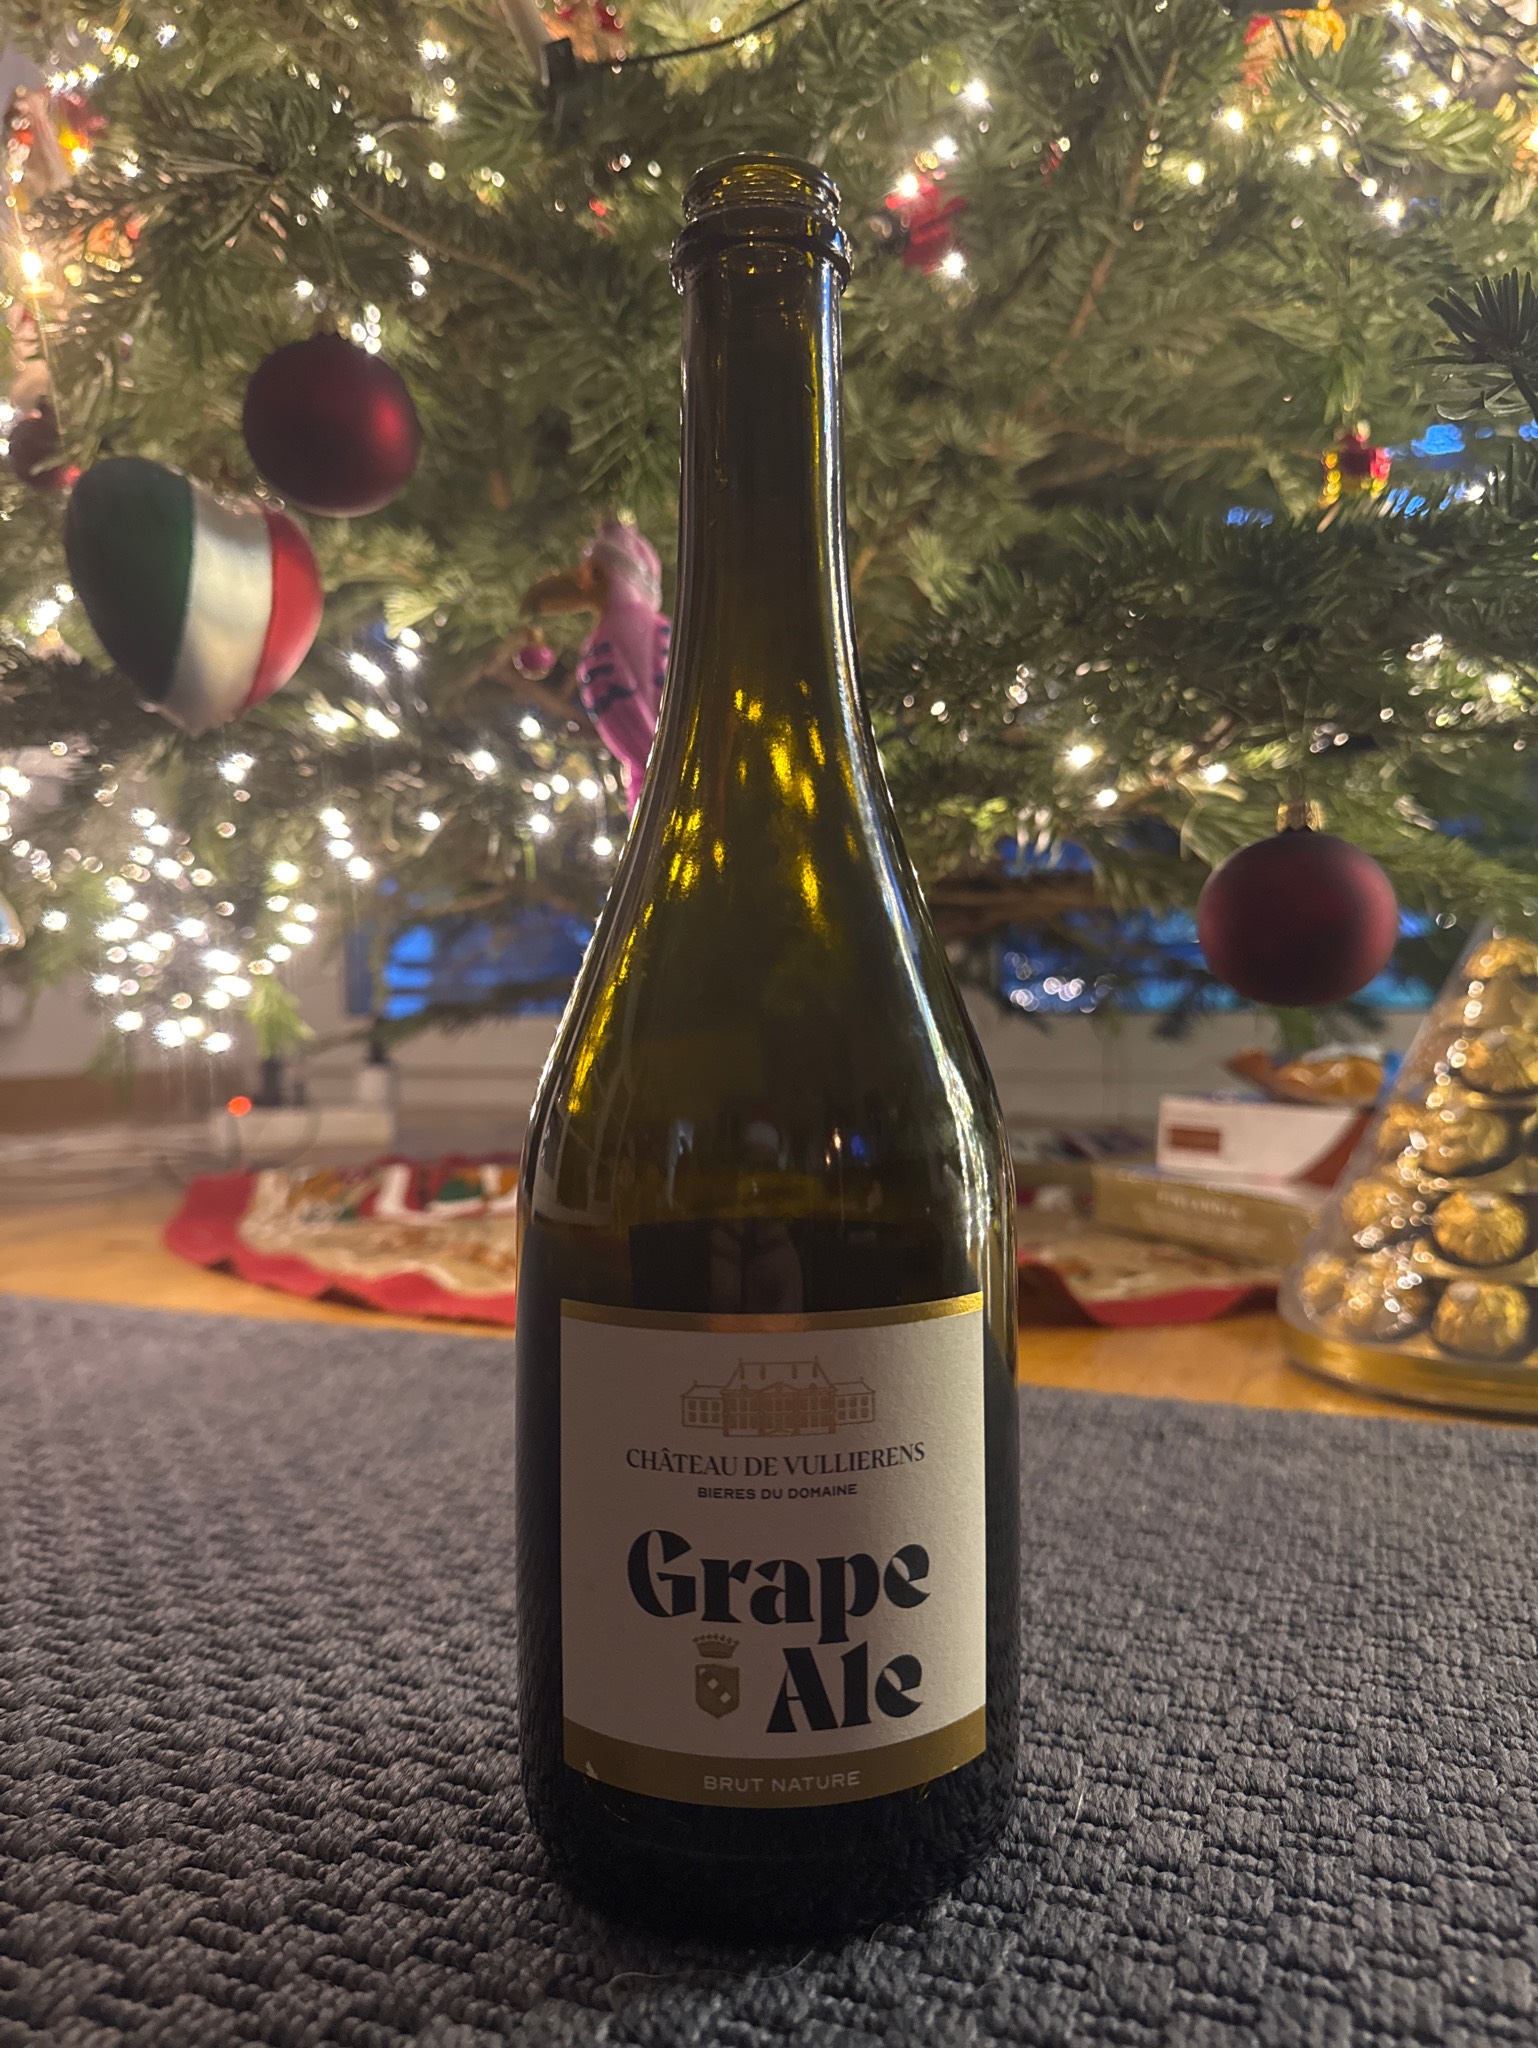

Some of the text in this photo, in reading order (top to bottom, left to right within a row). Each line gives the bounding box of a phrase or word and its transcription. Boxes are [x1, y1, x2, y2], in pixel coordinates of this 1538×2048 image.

[626, 1441, 925, 1476] CHÂTEAU DE VULLIERENS
[697, 1483, 858, 1500] BIERES DU DOMAINE
[627, 1529, 931, 1645] Grape
[765, 1640, 924, 1734] Ale
[703, 1770, 861, 1792] BRUT NATURE
